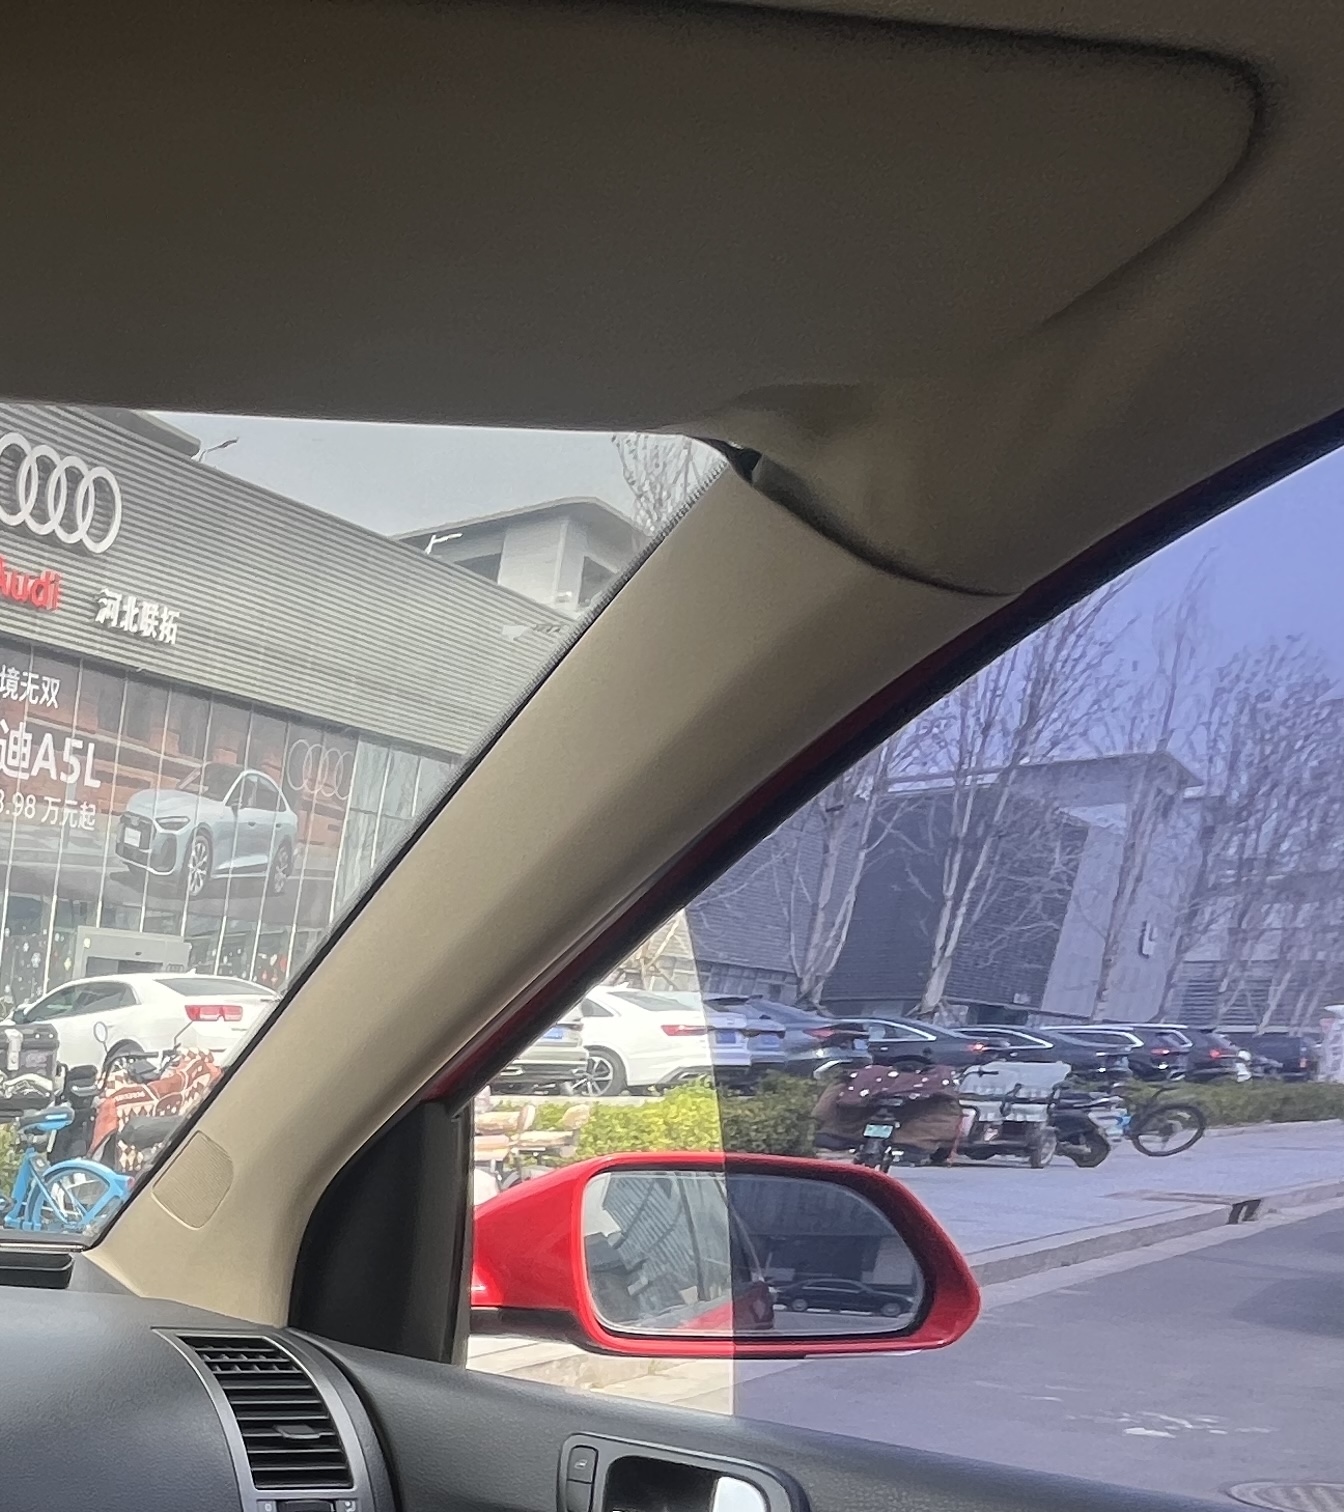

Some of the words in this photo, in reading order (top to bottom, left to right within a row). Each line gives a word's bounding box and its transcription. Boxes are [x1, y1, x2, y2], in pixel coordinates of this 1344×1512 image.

[95, 588, 180, 644] 河北联拓
[41, 796, 96, 830] 万元起
